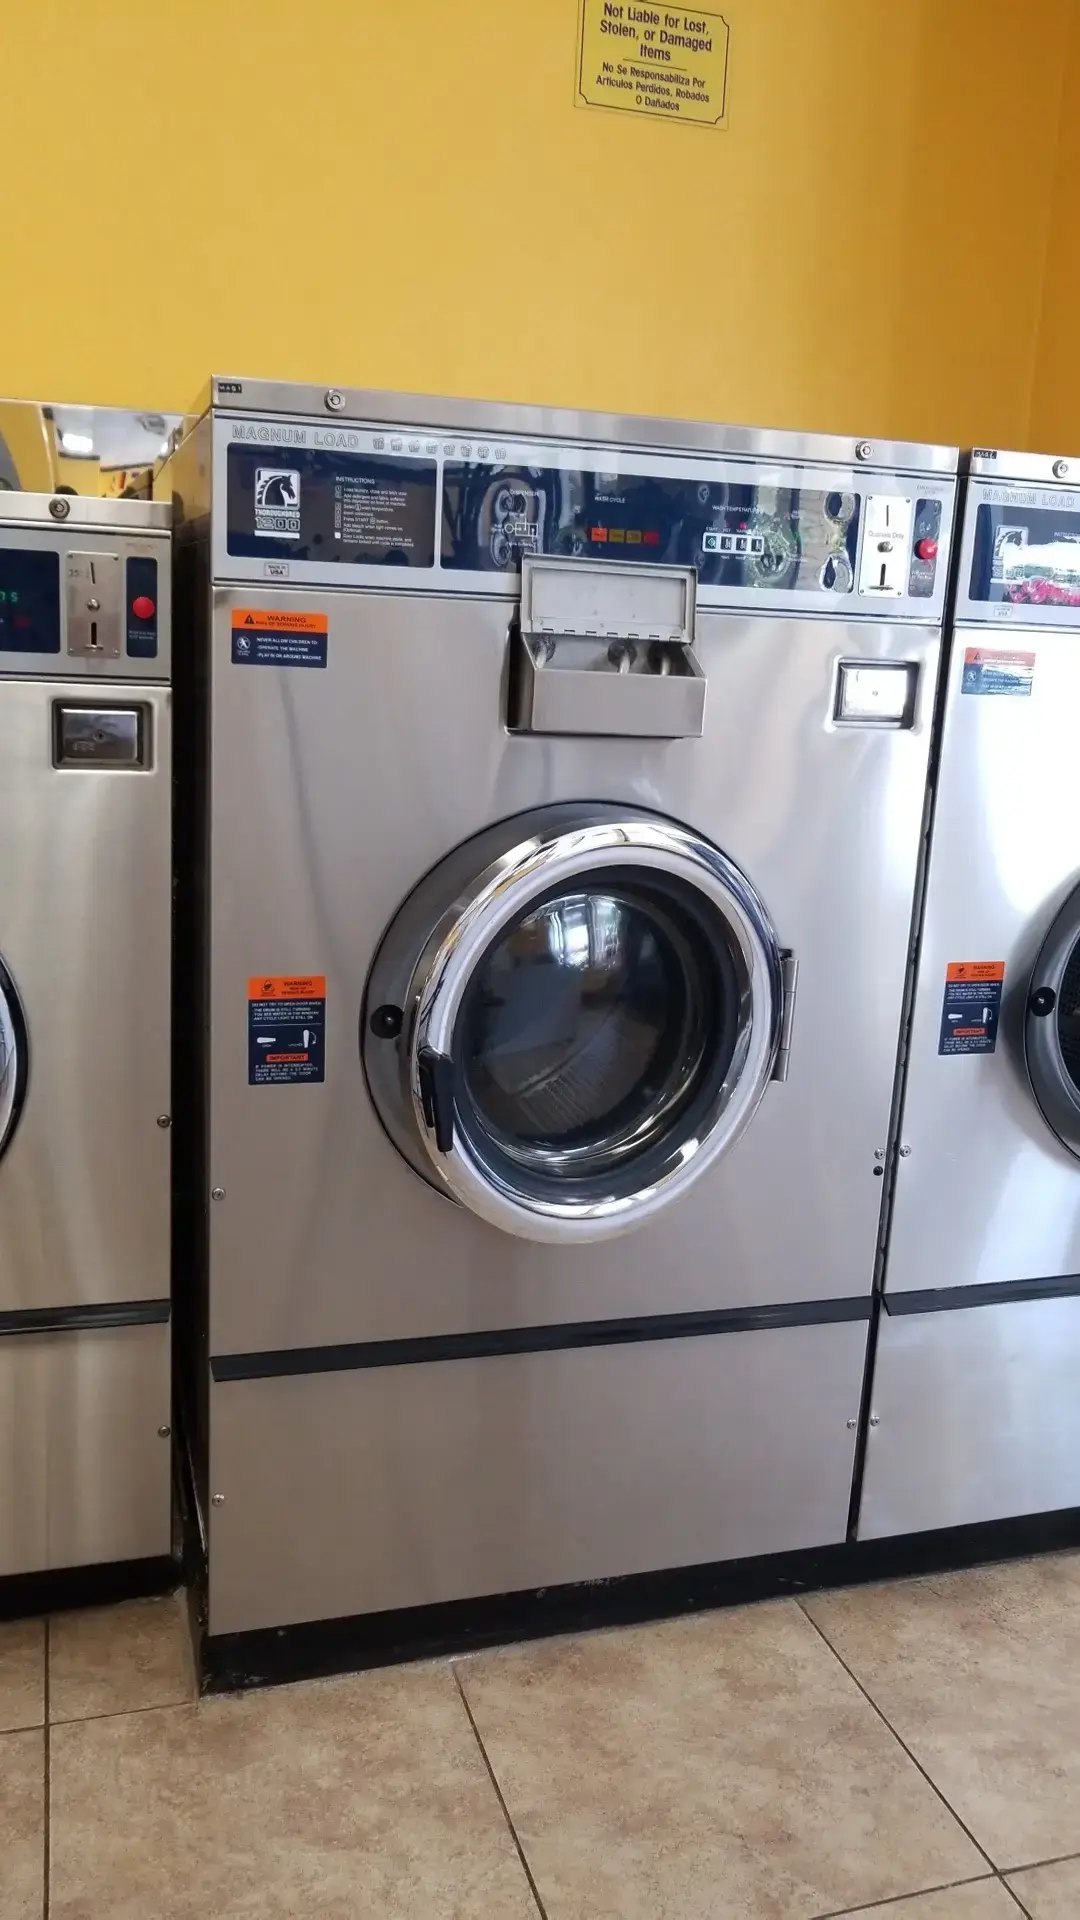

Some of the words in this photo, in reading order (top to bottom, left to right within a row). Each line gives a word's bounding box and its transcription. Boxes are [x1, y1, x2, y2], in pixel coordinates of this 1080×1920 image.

[604, 2, 623, 18] Not
[628, 6, 659, 26] Liable
[664, 13, 680, 29] for
[684, 17, 709, 35] Lost,
[600, 20, 639, 41] Stolen,
[644, 29, 656, 40] or
[660, 30, 712, 52] Damaged
[640, 44, 671, 61] Items
[602, 62, 614, 73] No
[617, 64, 627, 74] Se
[630, 66, 690, 86] Responsabiliza
[693, 77, 706, 88] Por
[636, 81, 673, 97] Perdidos,
[675, 89, 709, 103] Robados
[636, 95, 642, 105] O
[645, 96, 680, 111] Dañados
[232, 425, 306, 443] MAGNUM
[314, 432, 359, 448] LOAD
[336, 476, 375, 484] INSTRUCTIONS
[983, 489, 1036, 504] MAGNUM
[1042, 494, 1074, 508] LOAD
[255, 516, 300, 531] 1200
[892, 532, 904, 540] Only
